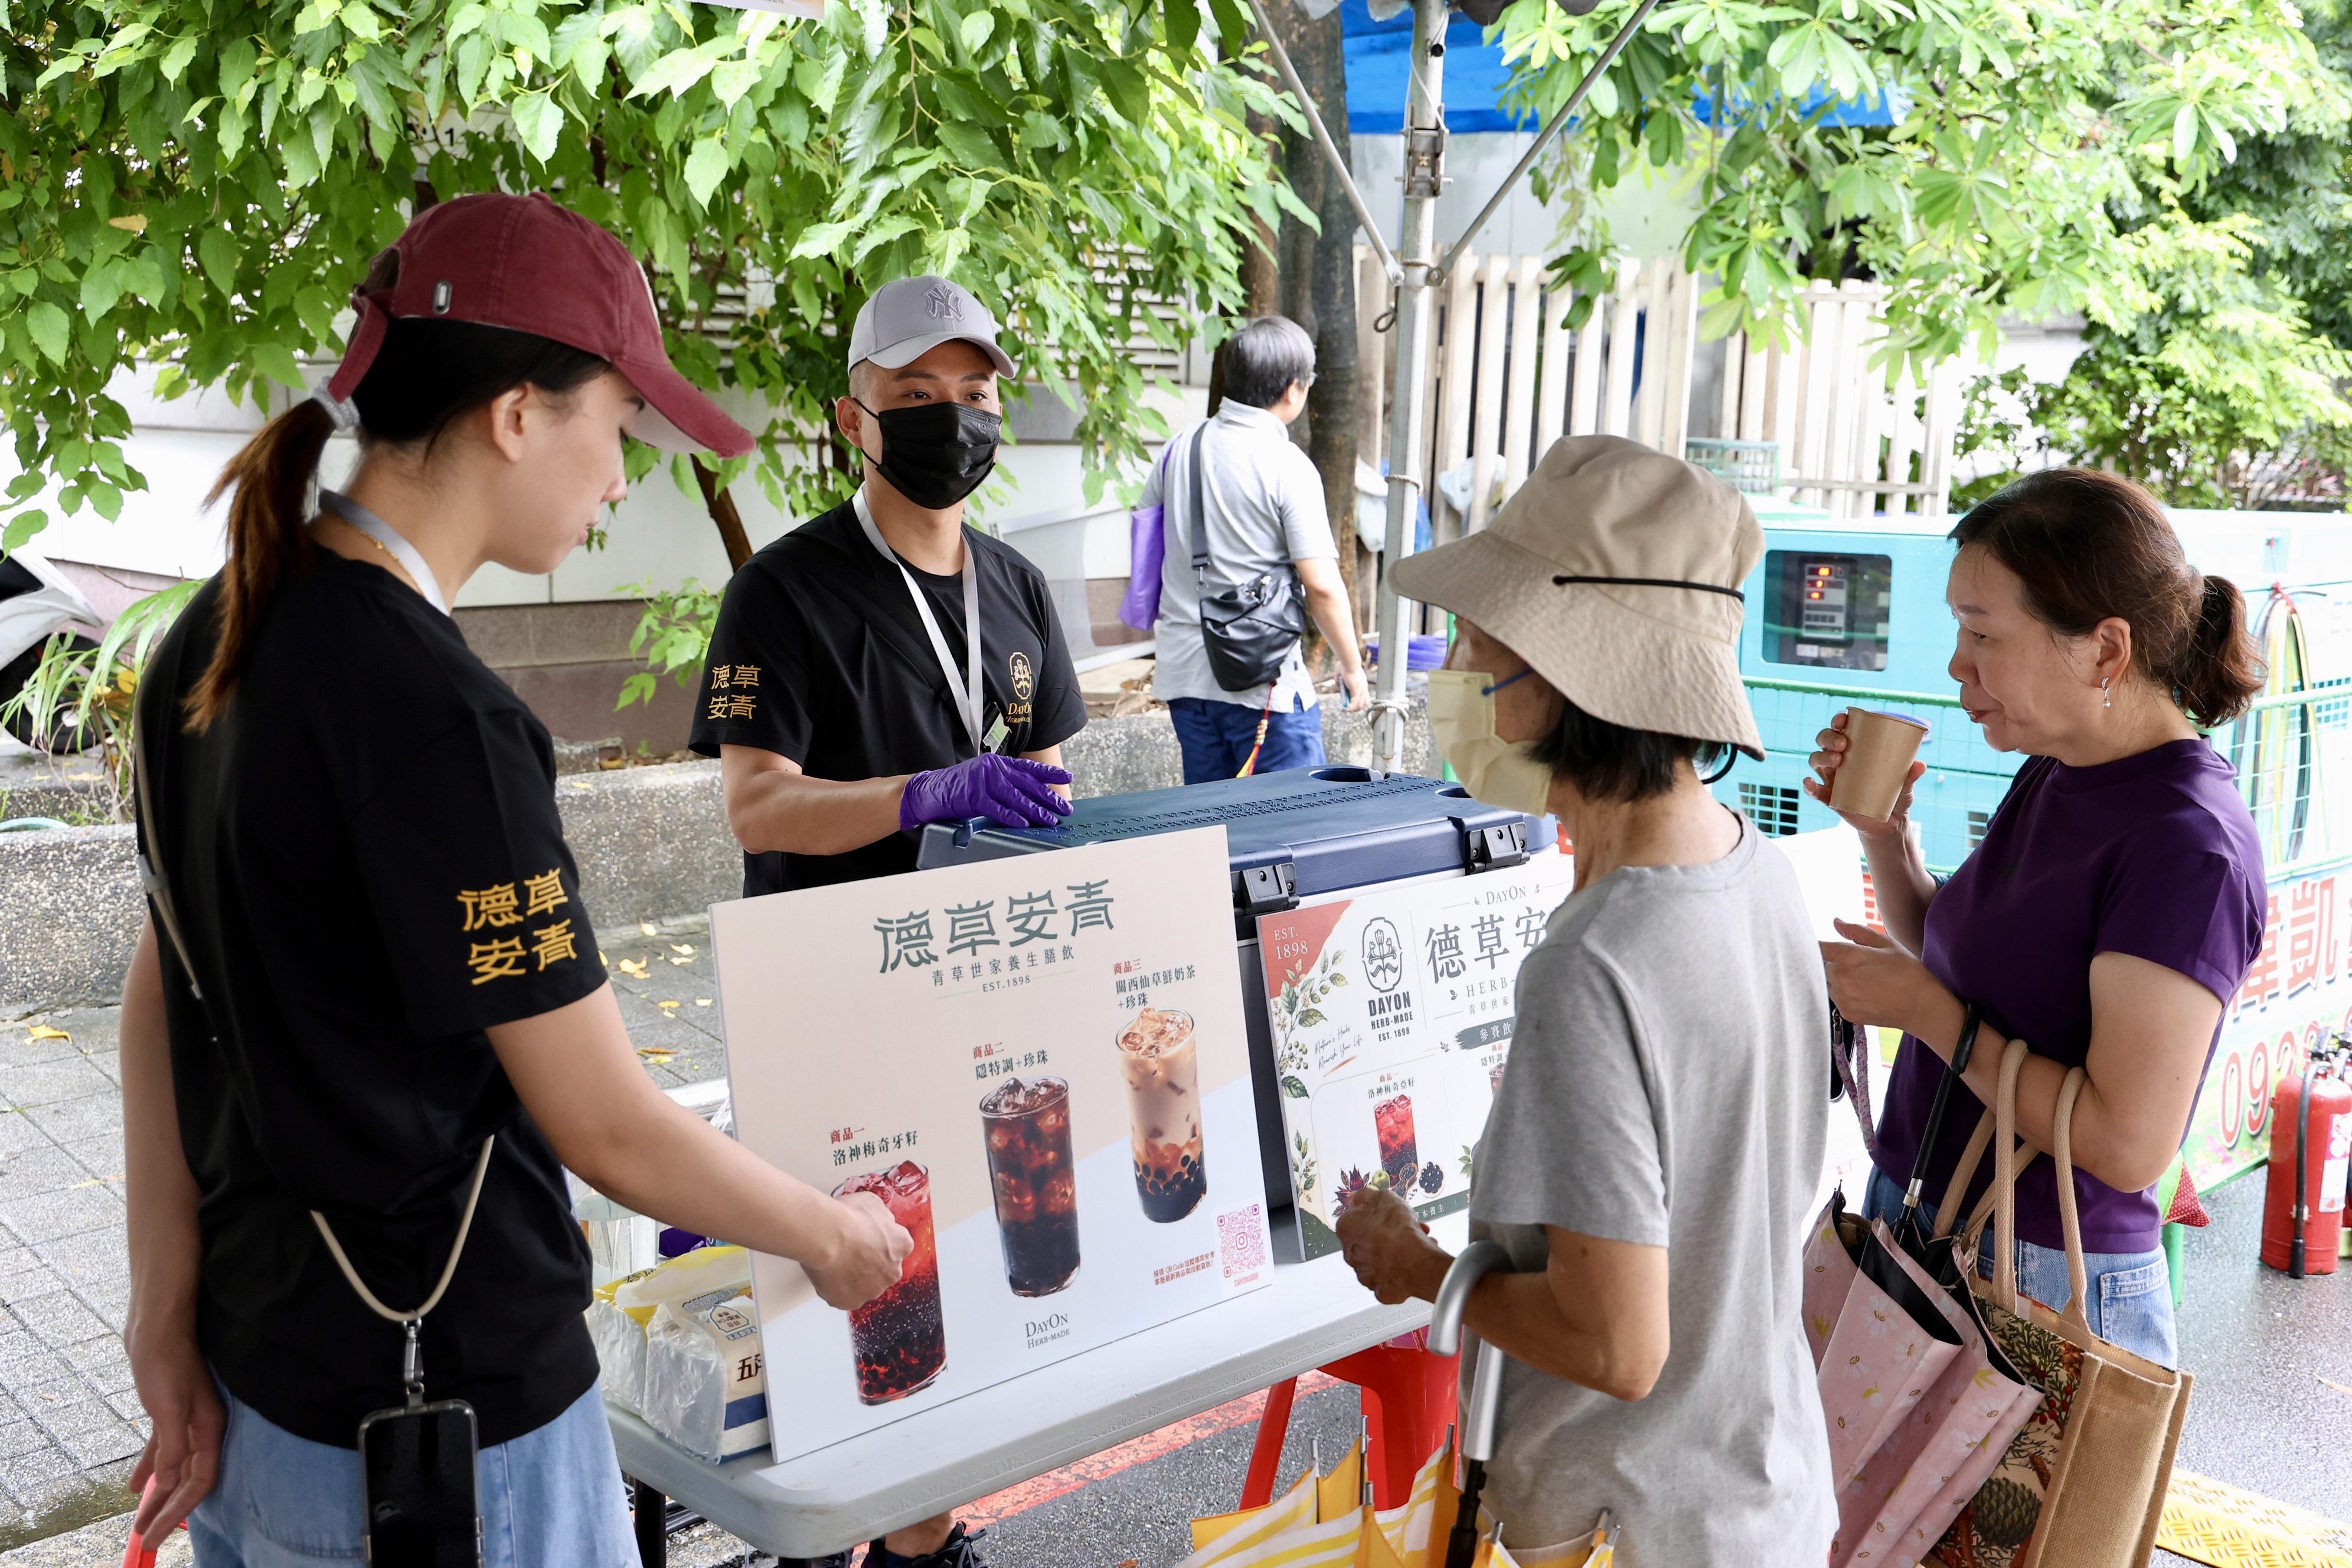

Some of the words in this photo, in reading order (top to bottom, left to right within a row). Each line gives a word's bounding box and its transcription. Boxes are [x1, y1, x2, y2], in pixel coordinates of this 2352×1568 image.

[711, 664, 762, 690] 德草
[708, 695, 757, 720] 安青
[456, 867, 569, 932] 德草
[874, 879, 1114, 974] 德草安青
[1274, 926, 1299, 940] EST.
[468, 919, 577, 985] 安青
[1276, 940, 1308, 960] 1898
[1425, 907, 1547, 984] 德草安
[932, 945, 1074, 986] 青草世家養生膳飲
[1113, 959, 1142, 975] 商品三
[982, 975, 1031, 992] EST.1898
[1116, 965, 1195, 995] 關西仙草鮮奶茶
[1466, 977, 1514, 998] HERB-
[1118, 992, 1148, 1010] +珍珠
[1368, 991, 1411, 1017] DAYON
[1469, 997, 1510, 1015] 青草世家
[1371, 1011, 1413, 1030] HERB-MADE
[1378, 1033, 1393, 1042] EST.
[1394, 1027, 1410, 1038] 1898
[973, 1041, 1004, 1059] 商品二
[975, 1049, 1048, 1080] 隱特調+珍珠
[830, 1127, 865, 1144] 商品一
[833, 1131, 918, 1167] 洛神梅奇牙籽
